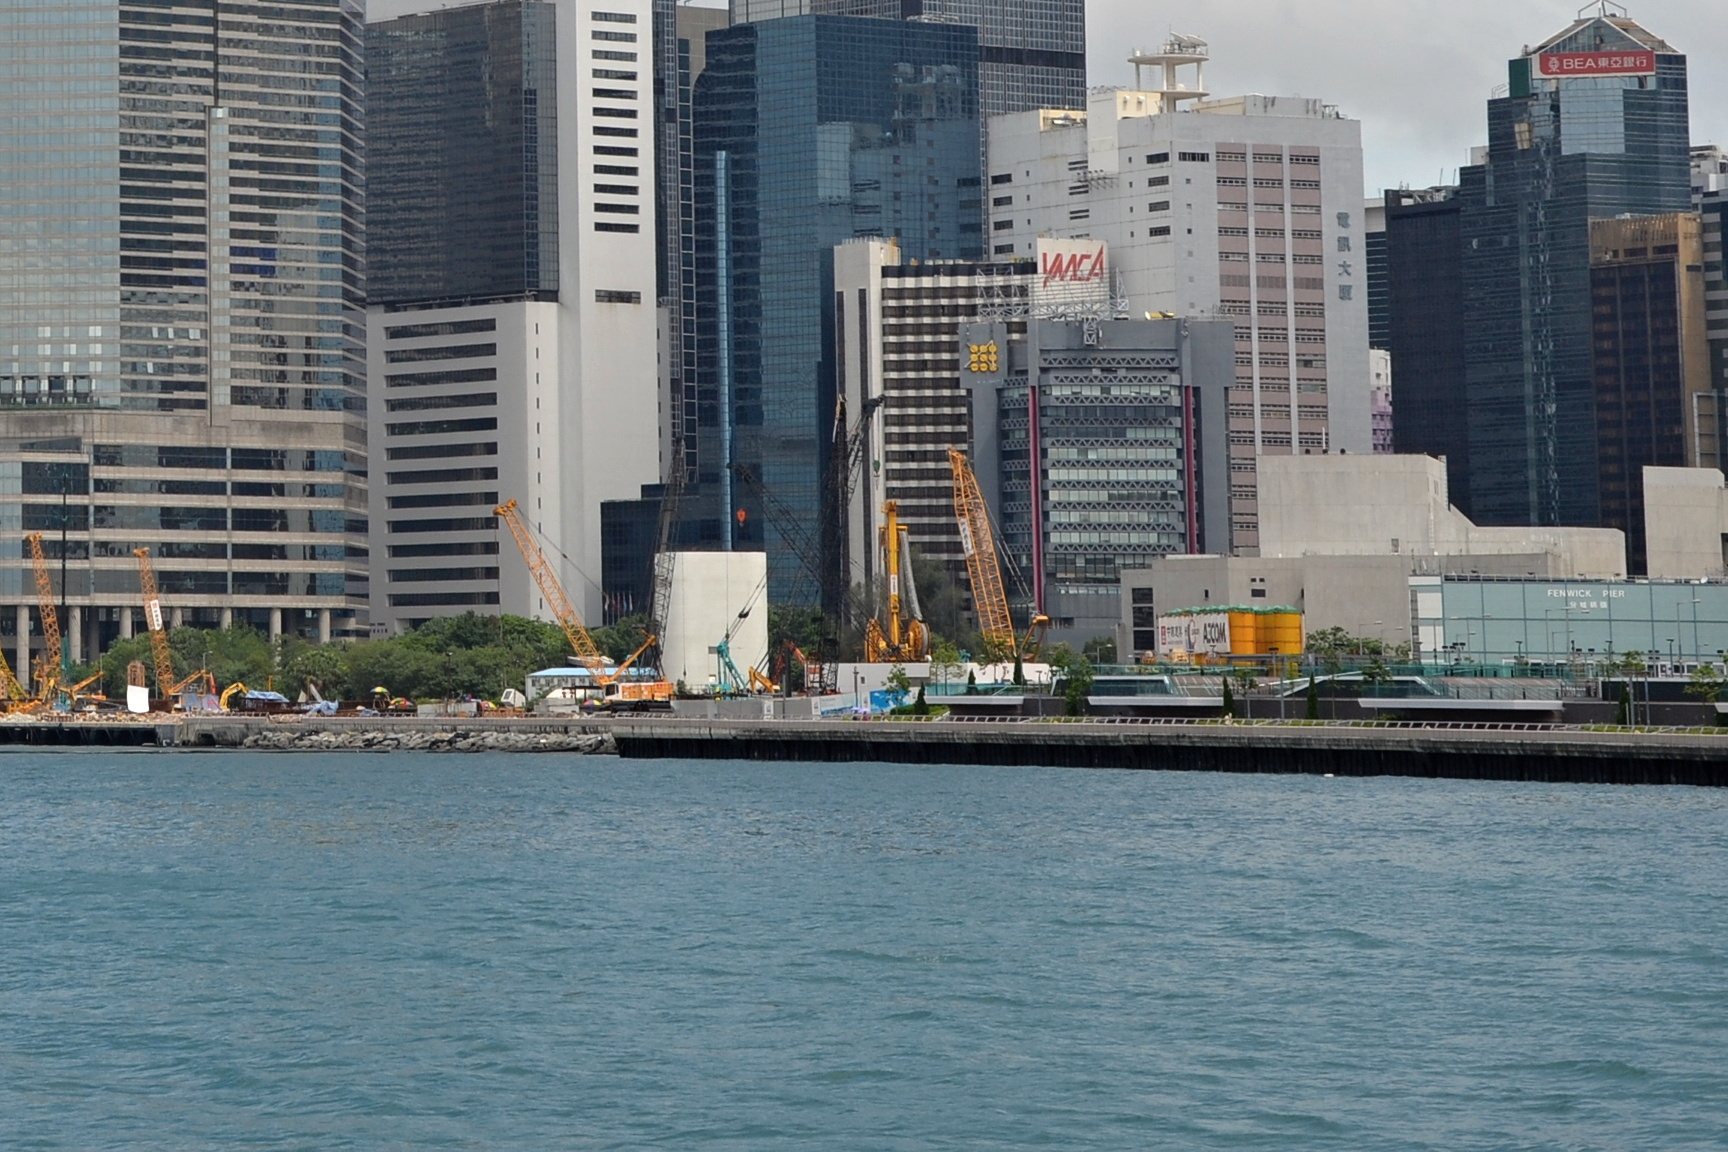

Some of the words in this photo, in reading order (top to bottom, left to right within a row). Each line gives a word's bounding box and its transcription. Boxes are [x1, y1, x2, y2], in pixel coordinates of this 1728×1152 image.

[1563, 57, 1597, 69] BEA
[1042, 244, 1104, 290] YMCA
[1547, 589, 1592, 598] FENWICK
[1602, 589, 1625, 598] PIER
